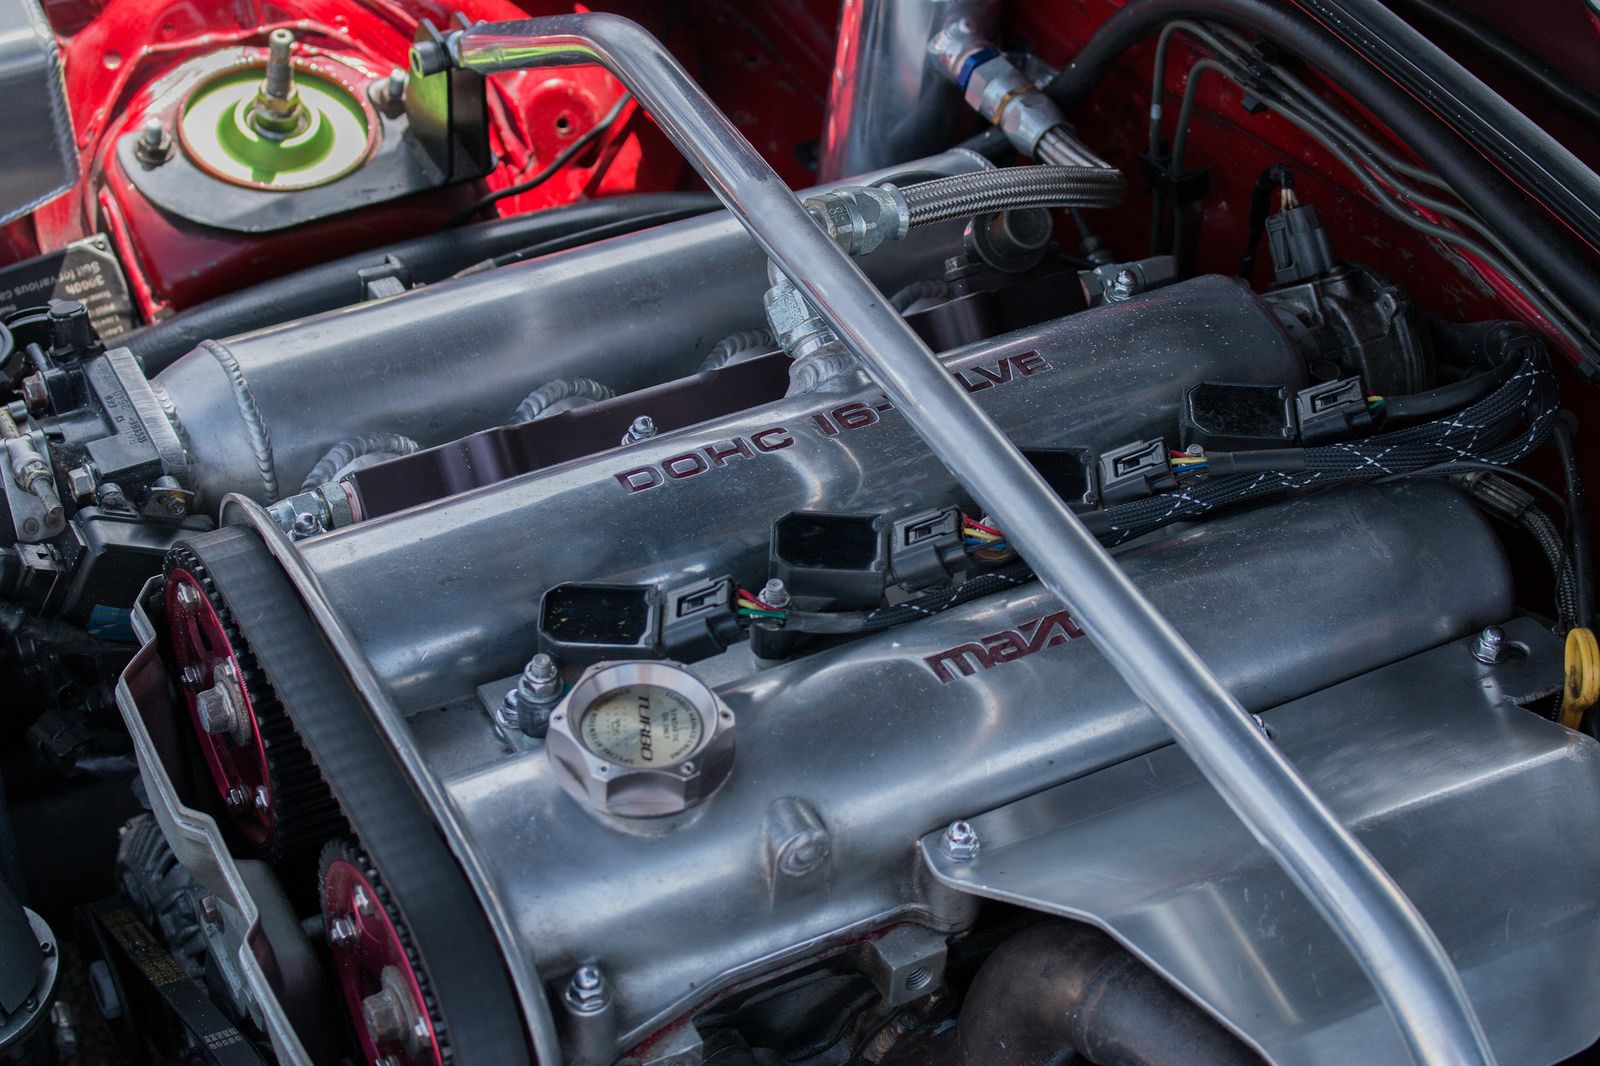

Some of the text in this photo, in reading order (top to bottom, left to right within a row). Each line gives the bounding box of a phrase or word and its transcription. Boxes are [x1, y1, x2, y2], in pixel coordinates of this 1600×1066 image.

[14, 275, 57, 296] various
[59, 268, 76, 282] for
[76, 261, 101, 277] Suit
[613, 427, 794, 495] DOHC
[922, 610, 1087, 685] maz
[638, 694, 654, 762] TURBO
